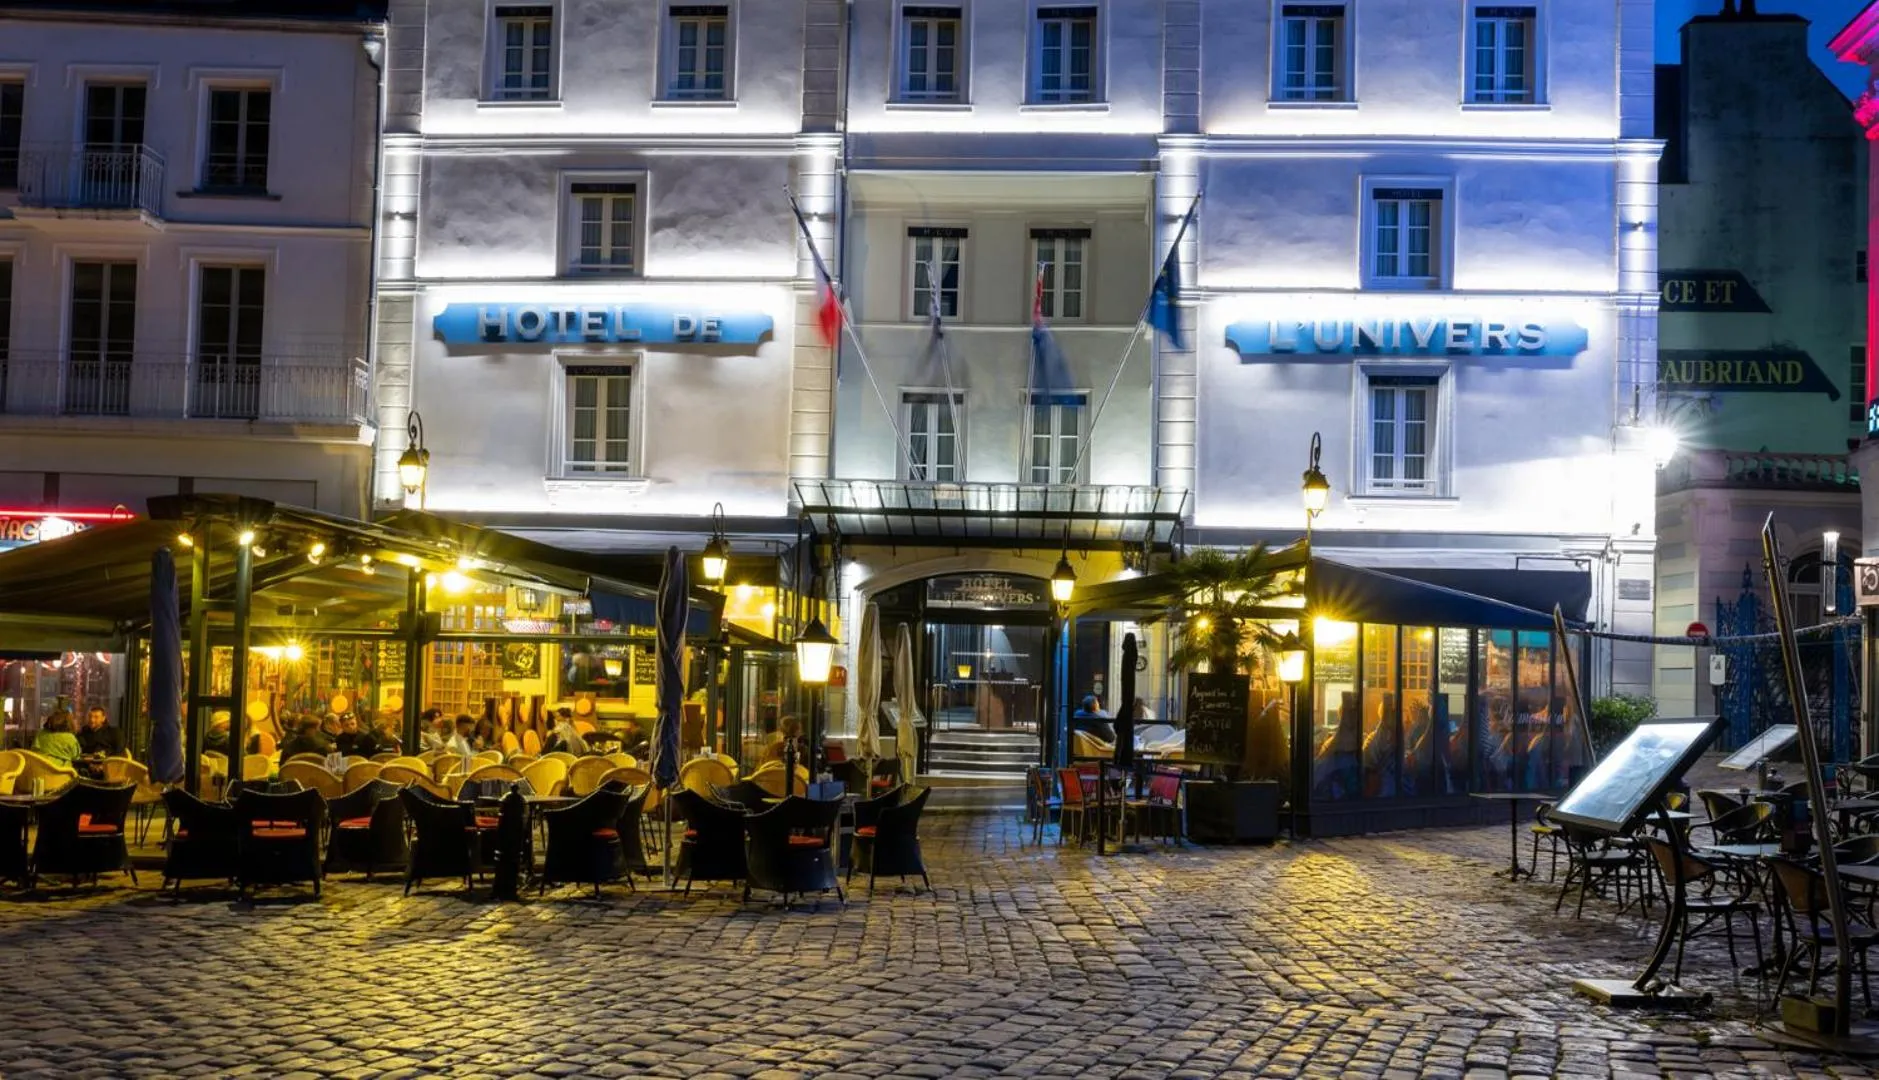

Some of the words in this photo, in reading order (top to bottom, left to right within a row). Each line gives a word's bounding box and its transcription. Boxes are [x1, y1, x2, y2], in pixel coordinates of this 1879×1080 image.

[1658, 280, 1696, 303] CE
[1704, 280, 1737, 304] ET
[476, 304, 642, 338] HOTEL
[672, 313, 722, 337] DE
[1267, 317, 1548, 351] L'UNIVERS
[1657, 360, 1804, 384] AUBRIAND
